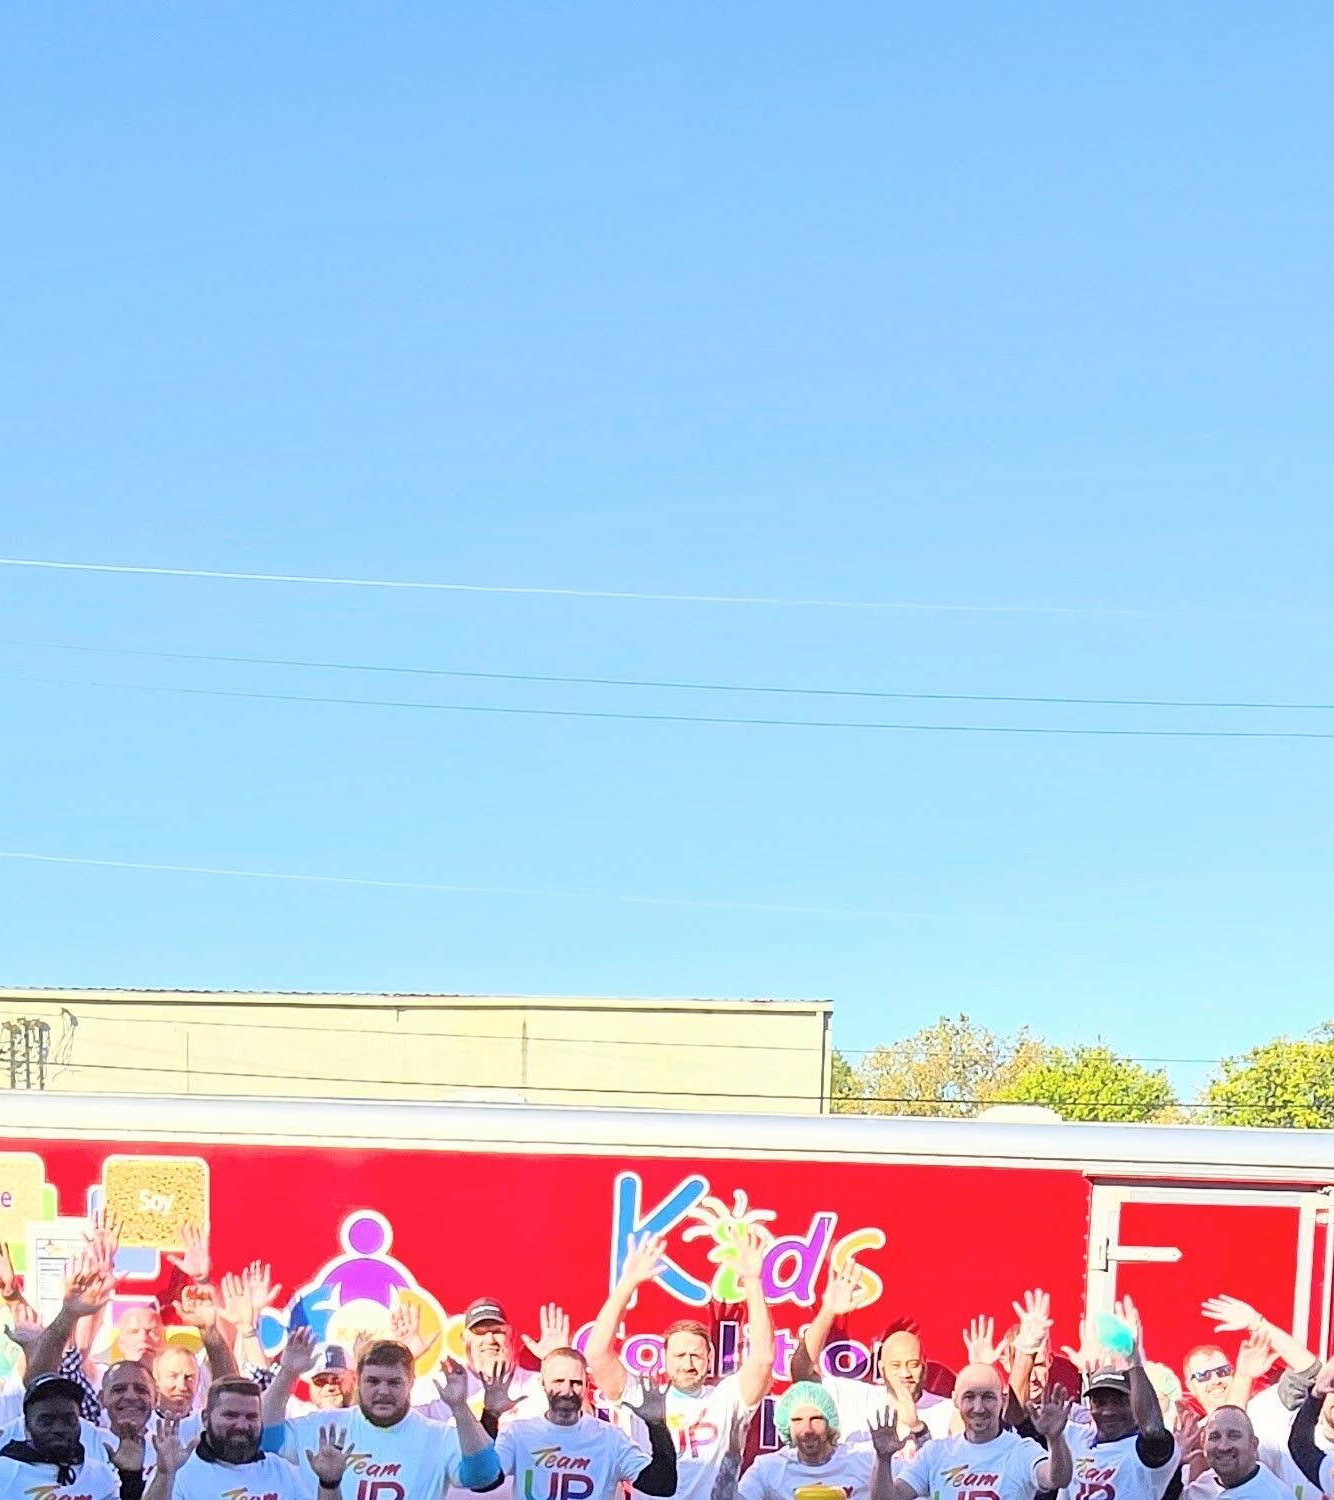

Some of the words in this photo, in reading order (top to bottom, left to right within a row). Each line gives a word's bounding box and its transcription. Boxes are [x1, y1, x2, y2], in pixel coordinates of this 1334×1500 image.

[138, 1188, 178, 1216] Soy
[346, 1453, 402, 1477] Team
[530, 1446, 590, 1469] Team
[940, 1464, 1000, 1489] Team
